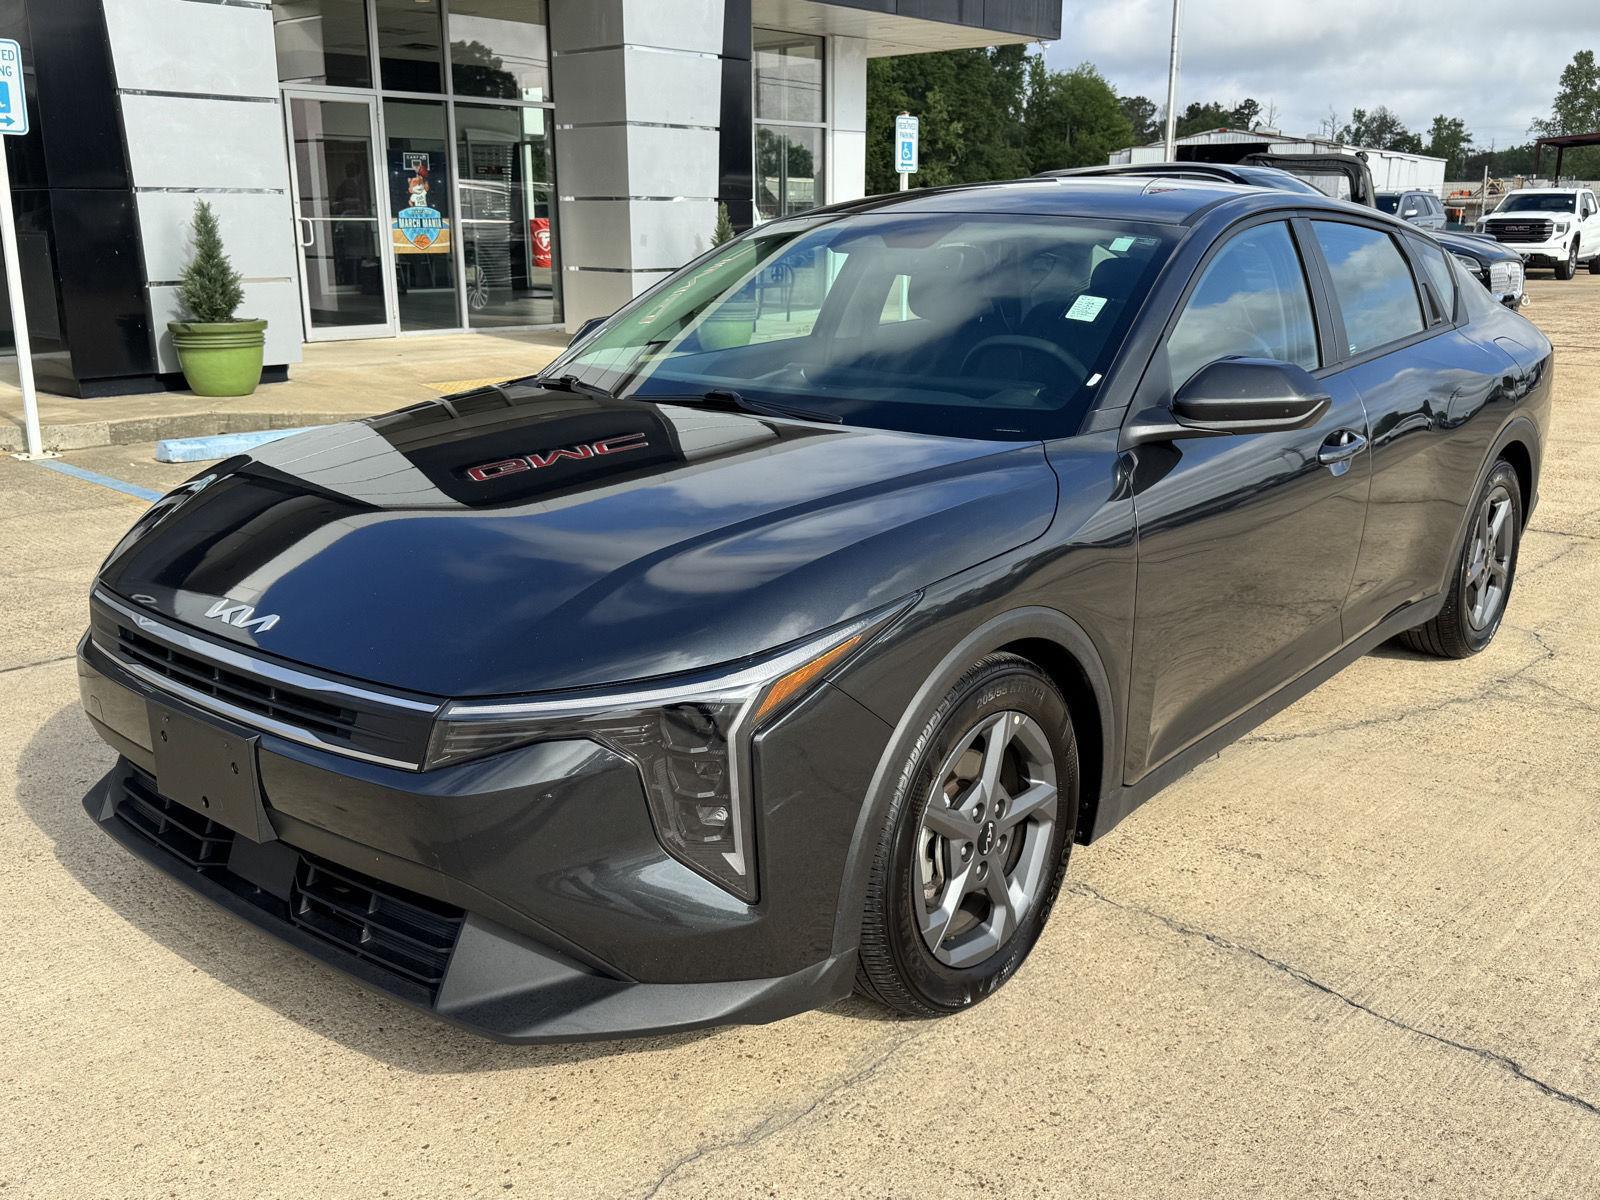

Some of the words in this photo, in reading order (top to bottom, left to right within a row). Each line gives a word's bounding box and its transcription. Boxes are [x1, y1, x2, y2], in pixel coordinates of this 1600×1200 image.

[399, 218, 421, 228] MARCH
[422, 218, 442, 228] MANIA
[204, 599, 280, 633] KIA
